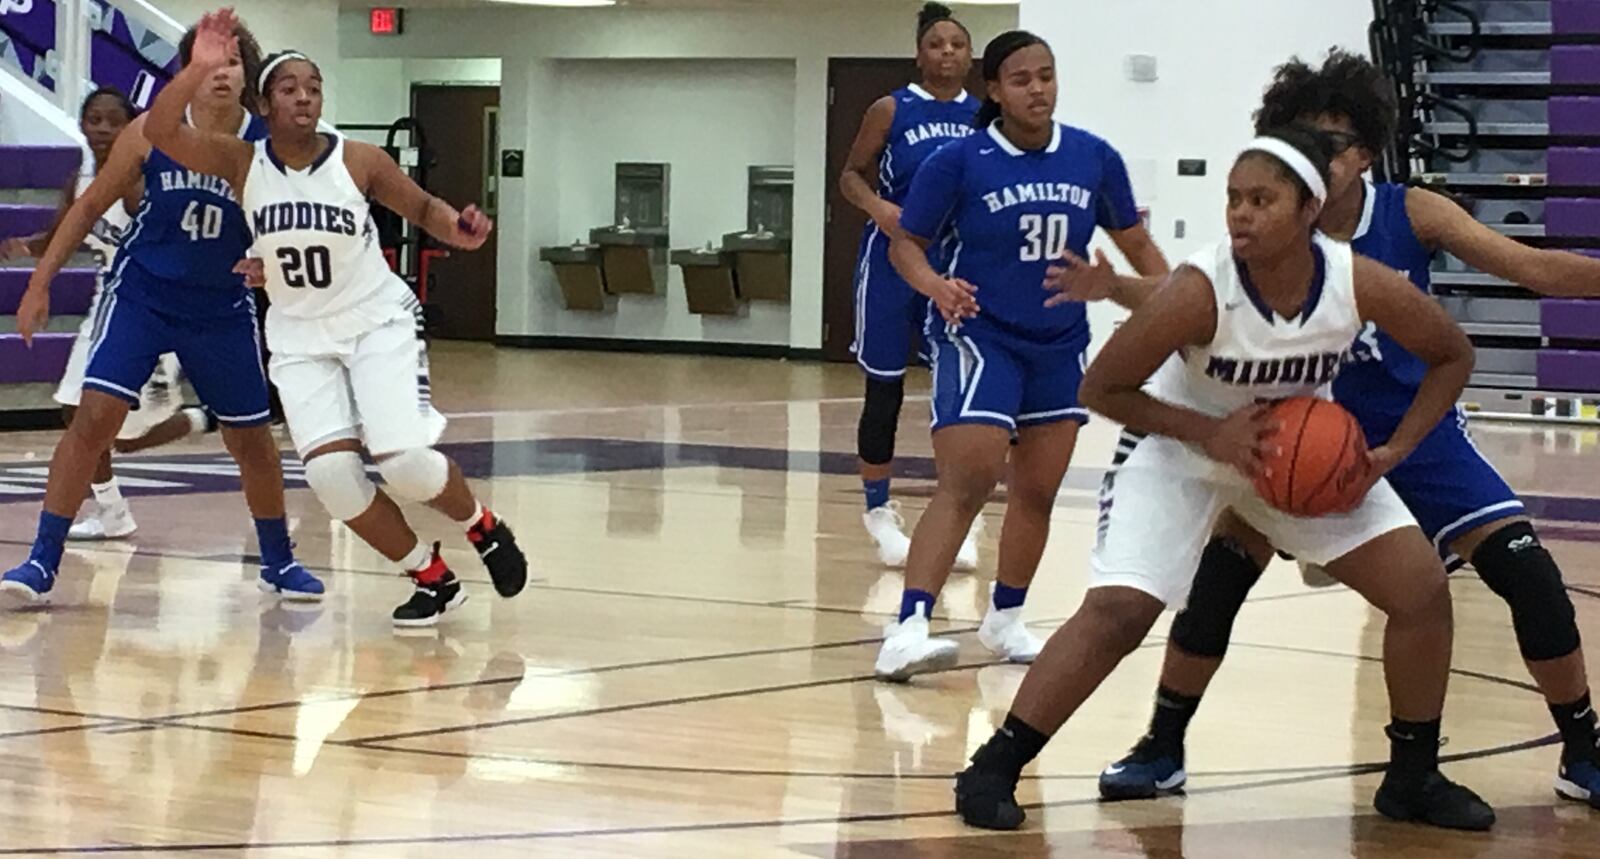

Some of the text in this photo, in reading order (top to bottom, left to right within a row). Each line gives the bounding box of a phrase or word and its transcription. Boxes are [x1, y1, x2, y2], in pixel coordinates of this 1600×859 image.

[981, 182, 1091, 213] HAMILTON
[180, 200, 223, 241] 40
[252, 200, 357, 239] MIDDIES
[1019, 213, 1068, 262] 30
[276, 245, 332, 289] 20
[1205, 351, 1344, 387] MIDDIE
